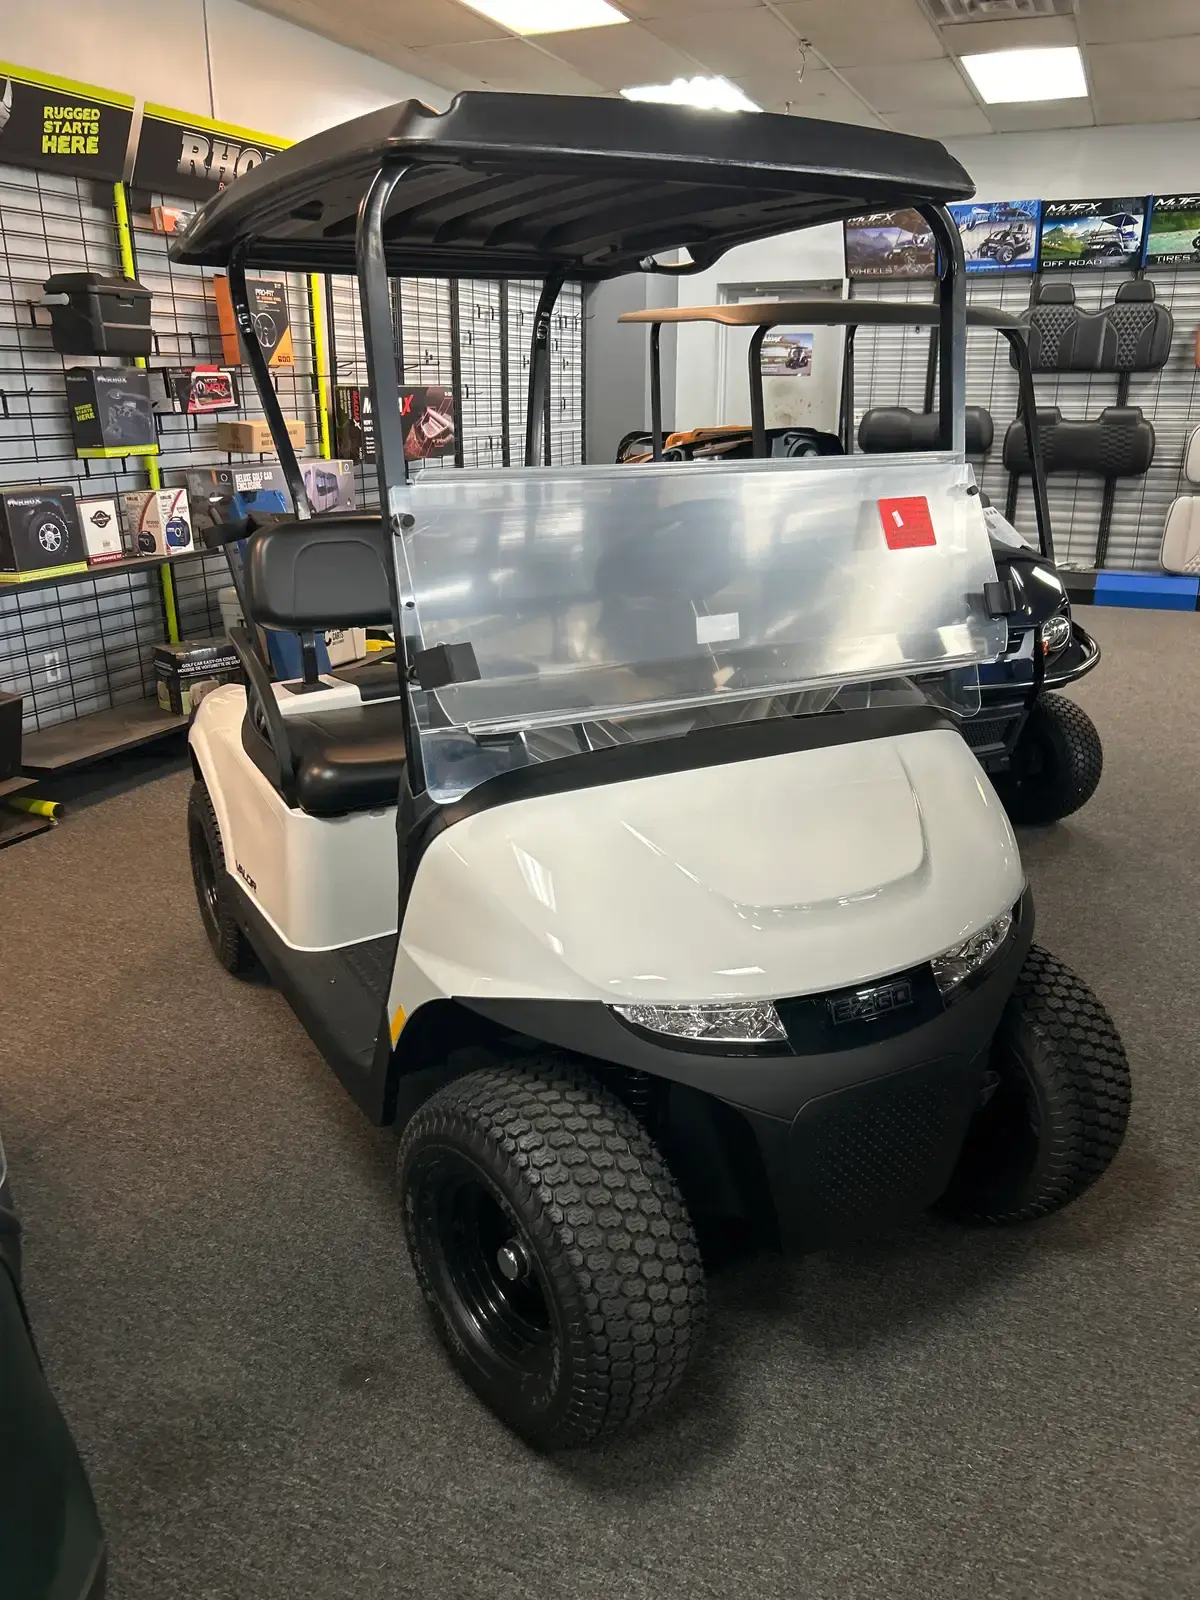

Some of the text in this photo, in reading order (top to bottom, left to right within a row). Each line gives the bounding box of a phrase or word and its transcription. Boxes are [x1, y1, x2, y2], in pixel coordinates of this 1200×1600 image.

[43, 106, 100, 120] RUGGED
[43, 120, 99, 134] STARTS
[42, 135, 99, 154] HERE
[177, 131, 275, 183] RHO
[1042, 260, 1066, 268] OFF
[1155, 254, 1191, 262] TIRES
[850, 267, 893, 275] WHEELS
[252, 471, 264, 481] GOLF
[263, 471, 273, 480] CAR
